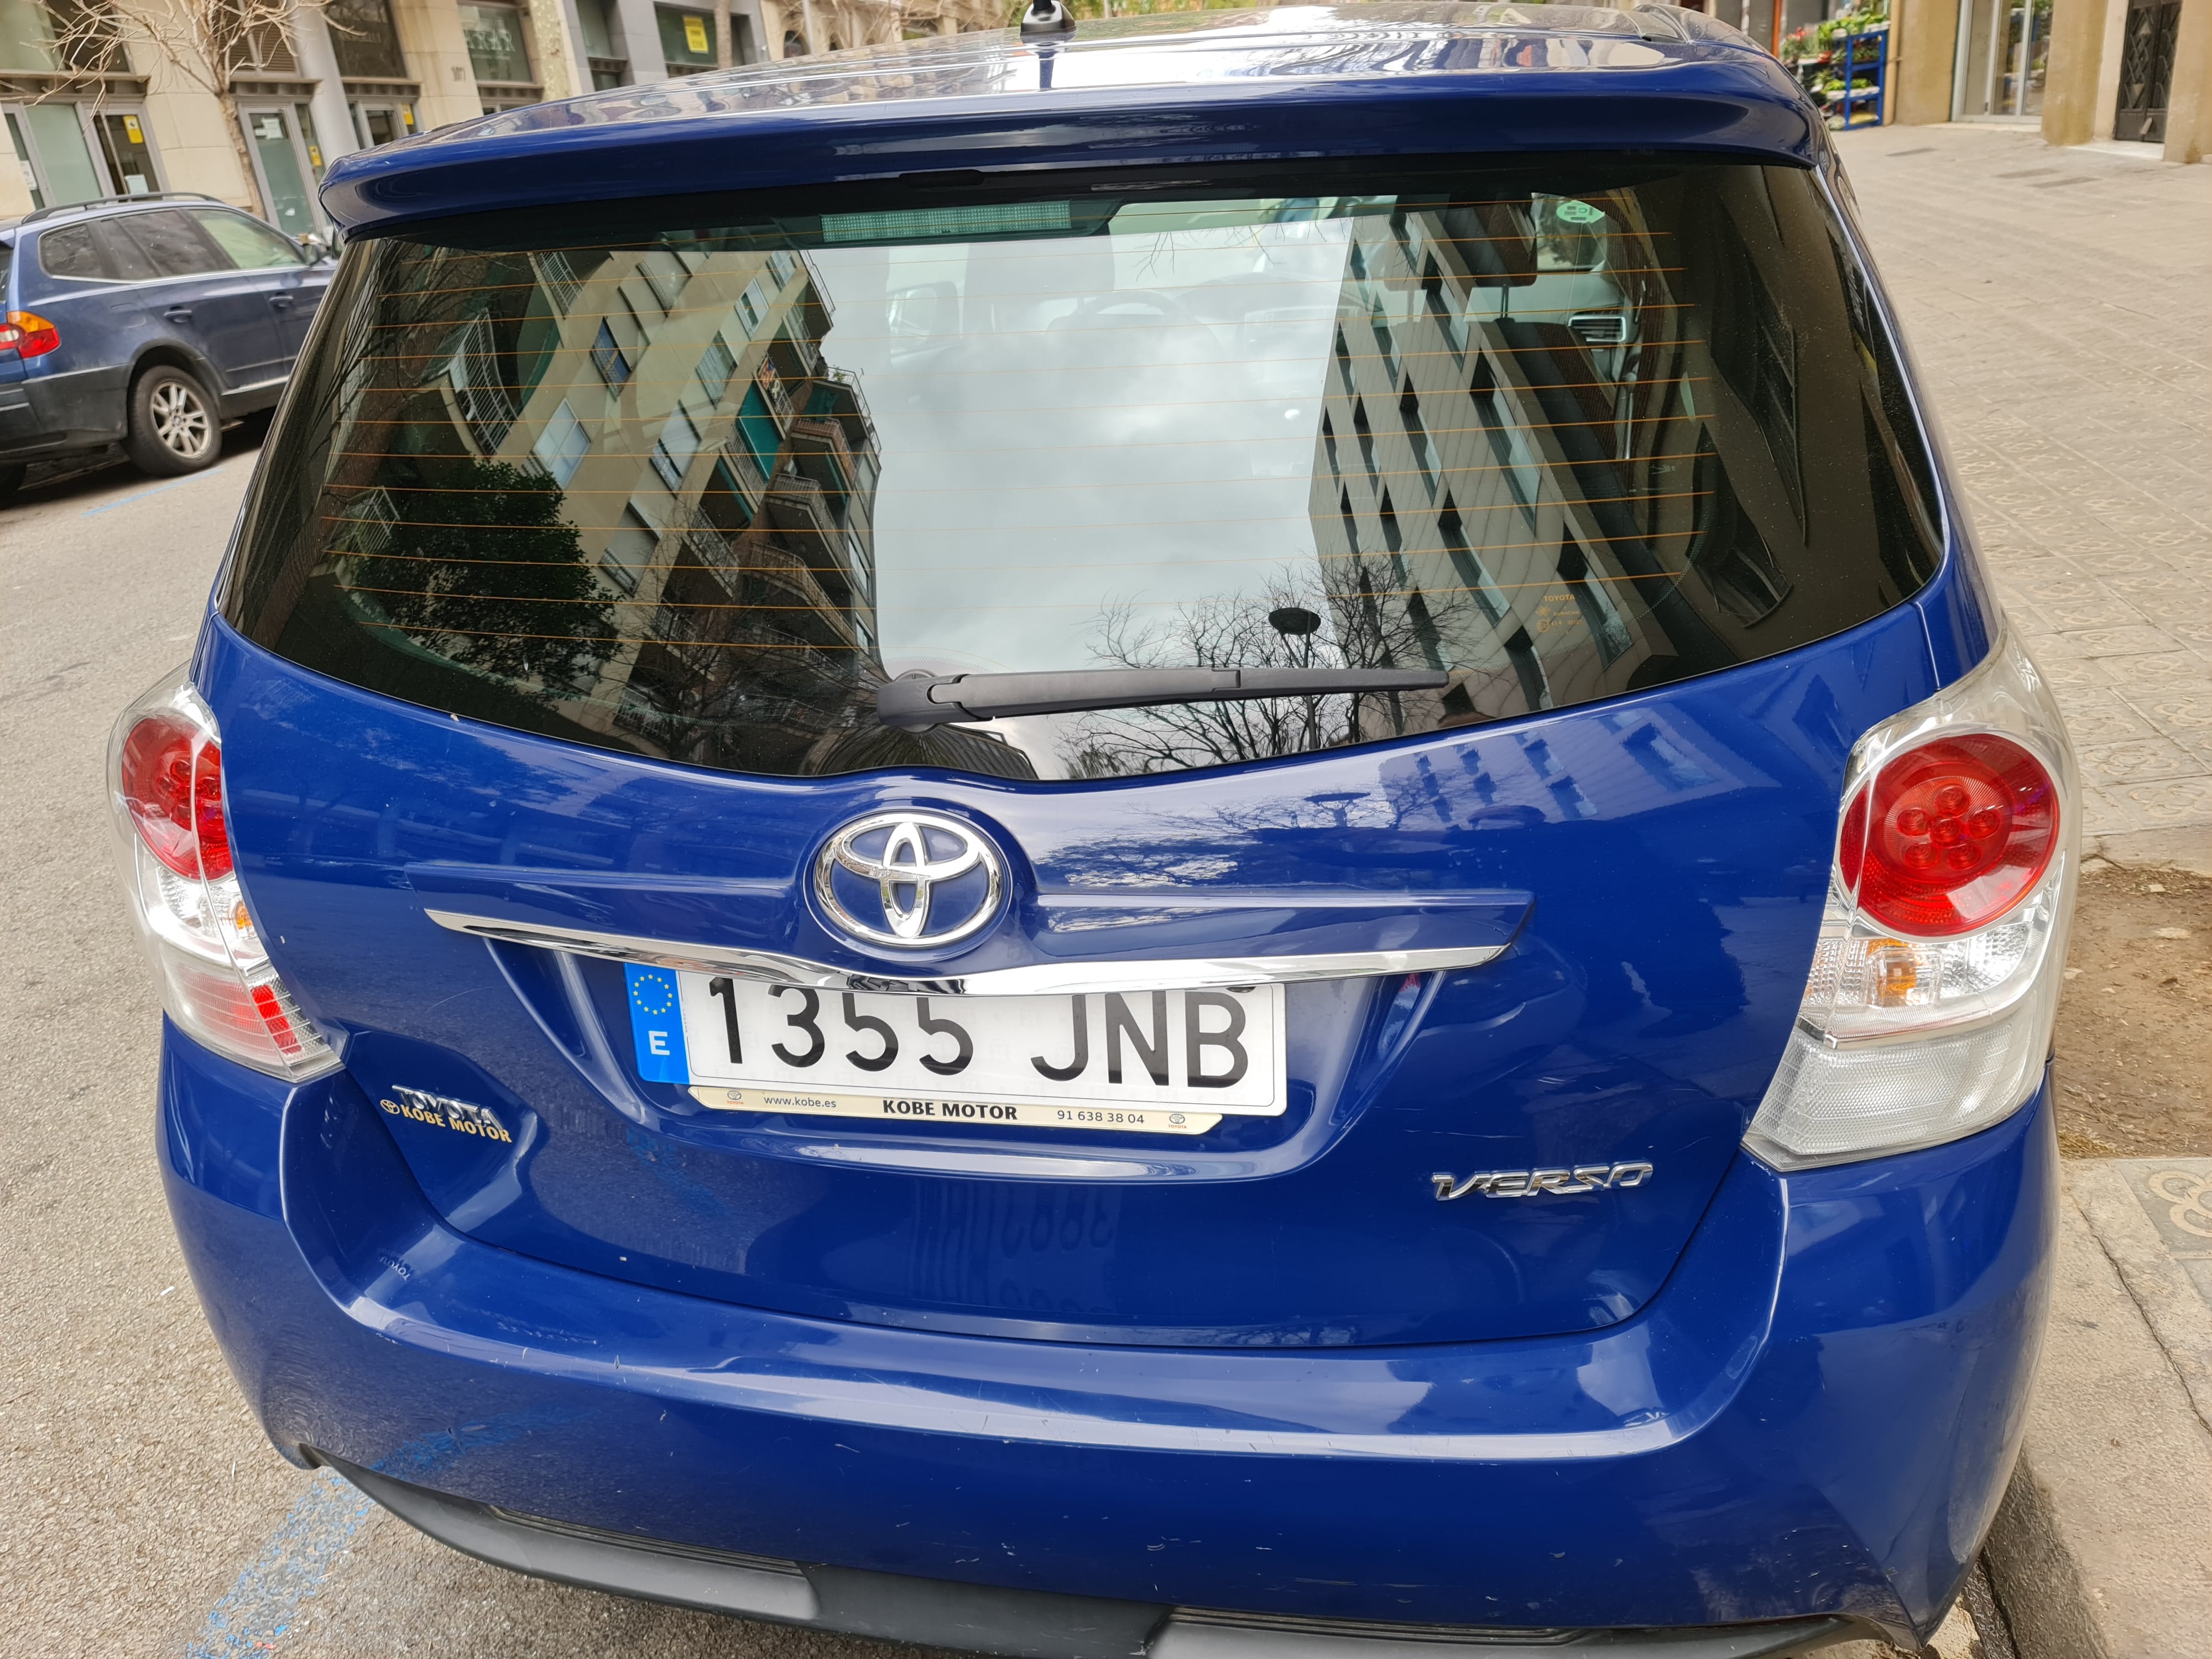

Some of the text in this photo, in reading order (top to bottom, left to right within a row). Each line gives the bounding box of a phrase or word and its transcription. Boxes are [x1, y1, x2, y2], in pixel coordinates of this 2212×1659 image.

[1543, 593, 1575, 602] TOYOTA
[648, 1030, 670, 1056] E
[709, 977, 1249, 1088] 1355 JNB
[400, 1104, 513, 1143] KOBE MOTOR
[763, 1096, 1145, 1124] www.kobe.es KOBE MOTOR 91 638 38 04
[1431, 1161, 1654, 1201] VERSO
